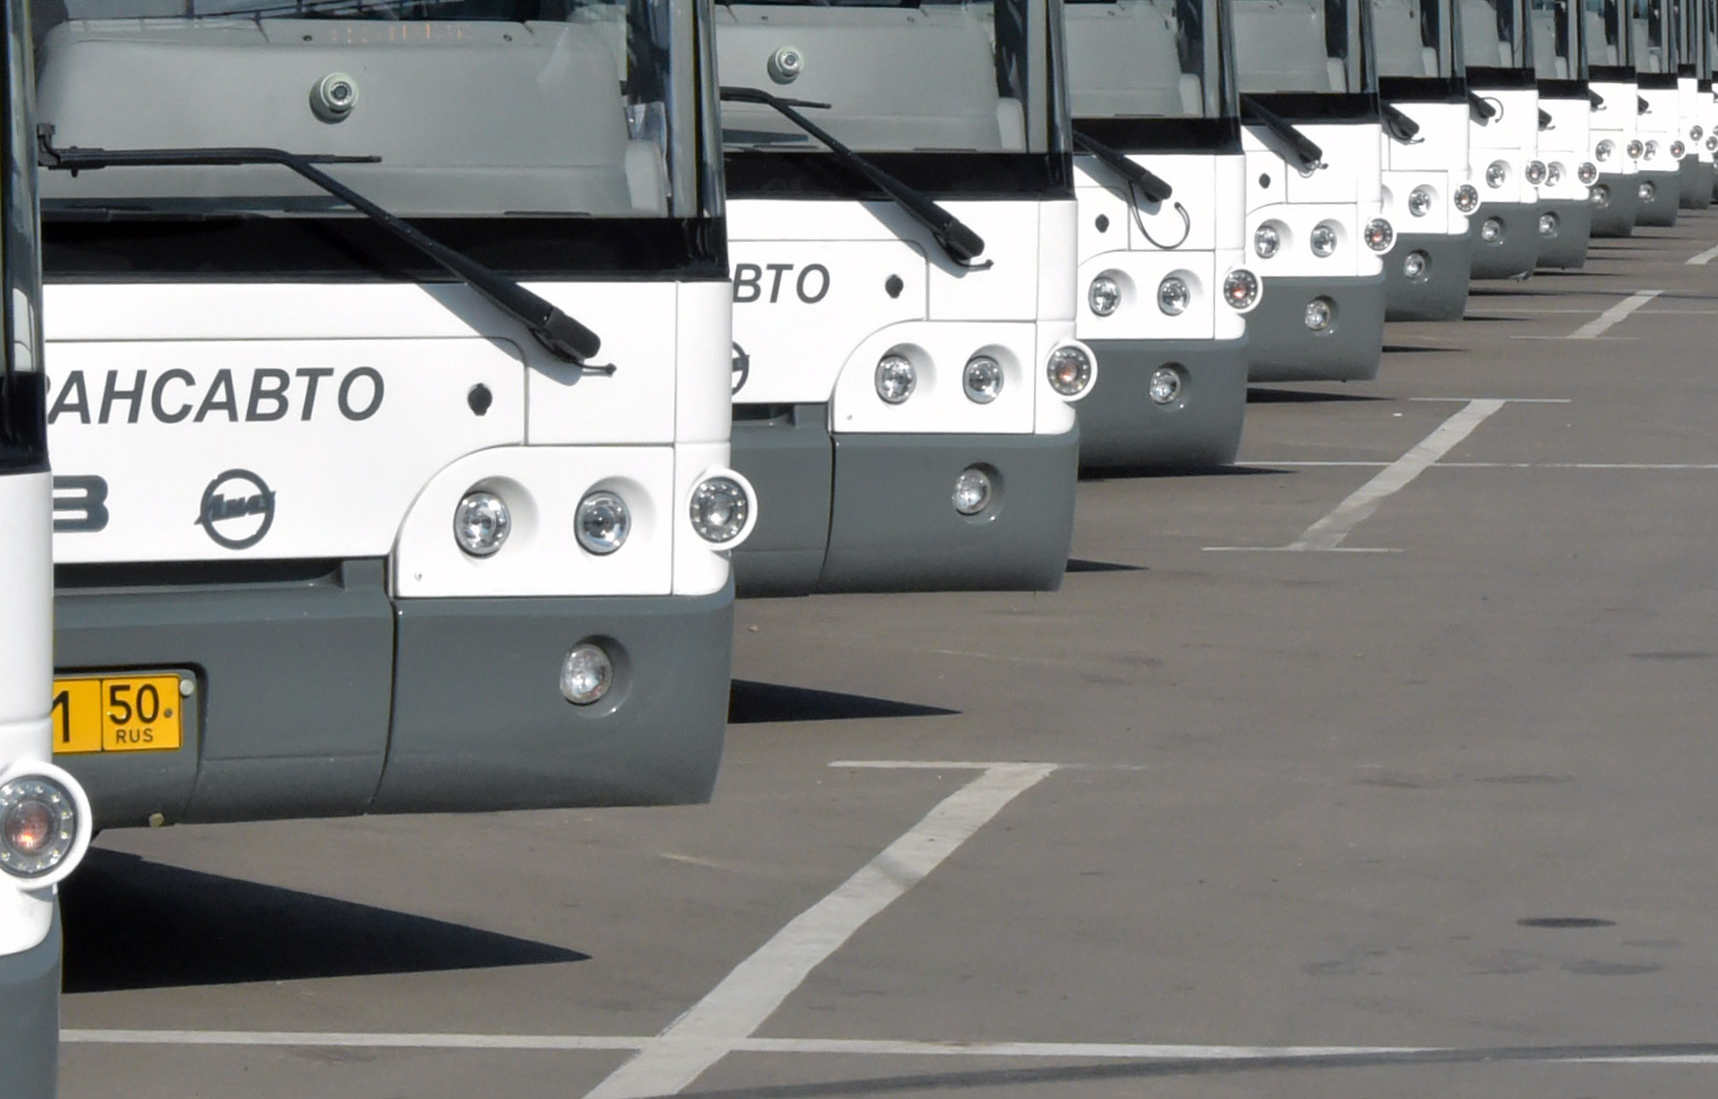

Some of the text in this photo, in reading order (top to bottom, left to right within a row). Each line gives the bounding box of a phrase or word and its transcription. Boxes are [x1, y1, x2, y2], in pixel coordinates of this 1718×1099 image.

[733, 263, 831, 305] ВТО
[46, 366, 385, 425] АНСАВТО
[108, 684, 159, 725] 50
[116, 728, 154, 744] RUS
